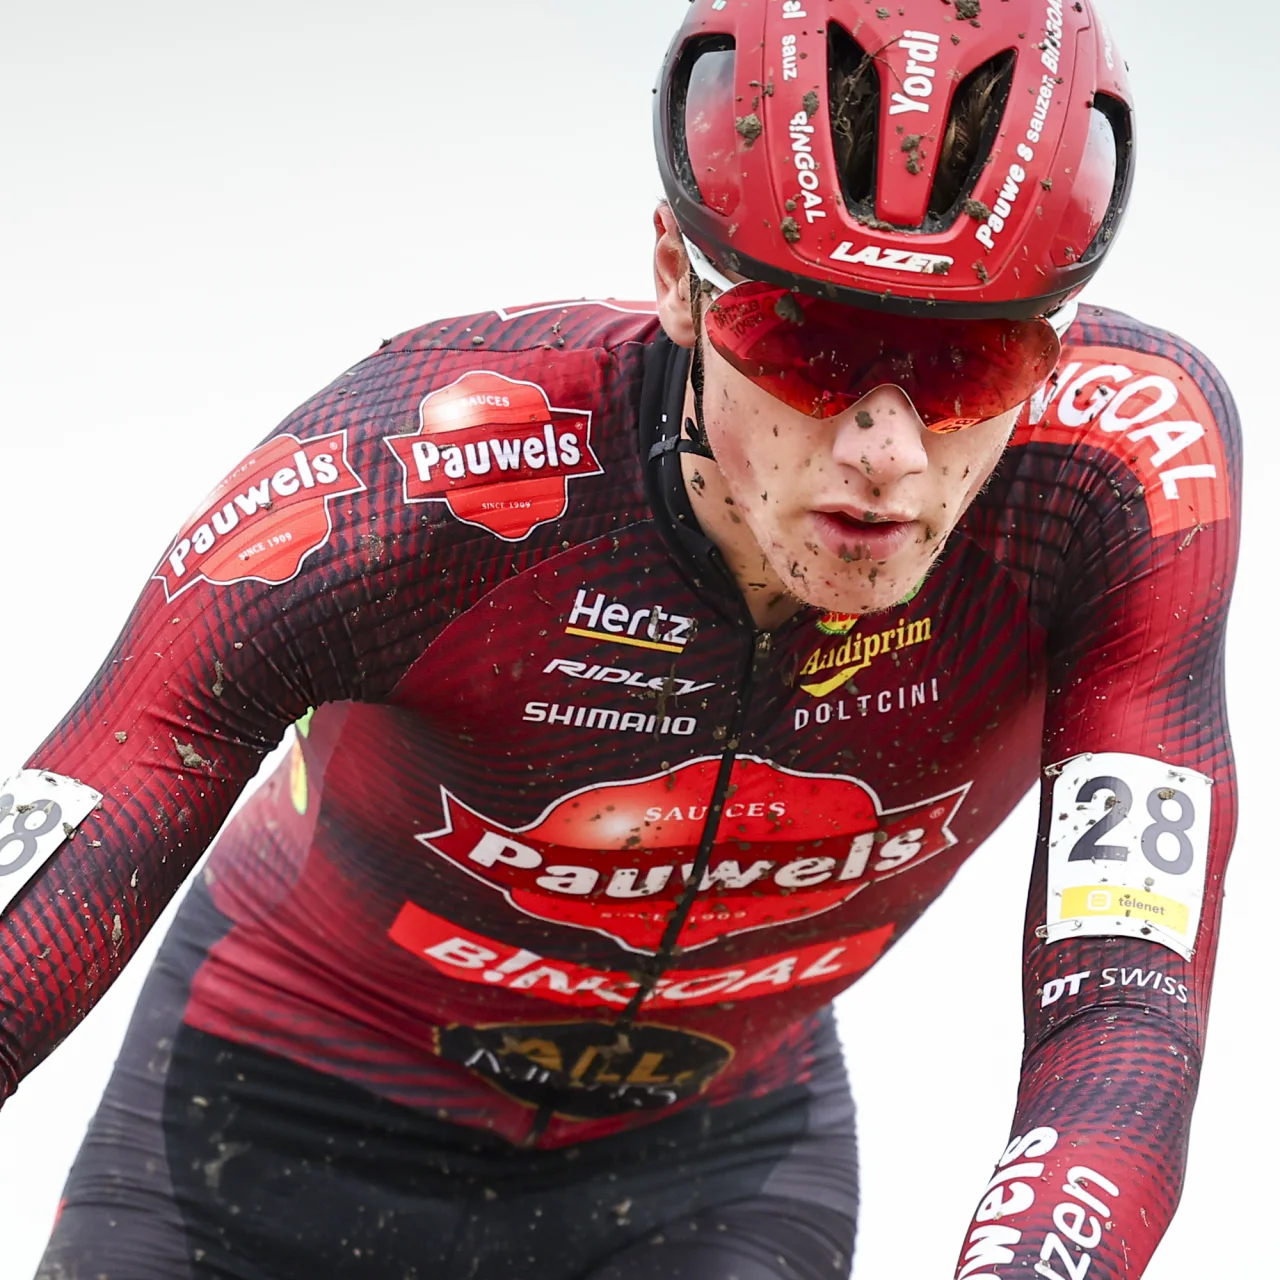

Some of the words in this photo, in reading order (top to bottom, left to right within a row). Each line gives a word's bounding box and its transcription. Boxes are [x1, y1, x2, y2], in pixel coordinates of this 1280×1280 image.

[889, 30, 940, 116] Yordi
[411, 423, 581, 482] Pauwels
[168, 450, 339, 577] Pauwels
[238, 541, 265, 561] SINCE
[267, 532, 293, 548] 1909
[568, 588, 691, 645] Hertz
[543, 658, 716, 695] RIDLEY
[522, 701, 697, 735] SHIMANO
[795, 678, 938, 731] DOLTCINI
[643, 801, 786, 822] SAUCES
[1067, 775, 1196, 875] 28
[466, 825, 926, 899] Pauwels
[1118, 896, 1166, 916] telenet
[1041, 971, 1090, 1008] DT
[1099, 967, 1188, 1004] SWISS
